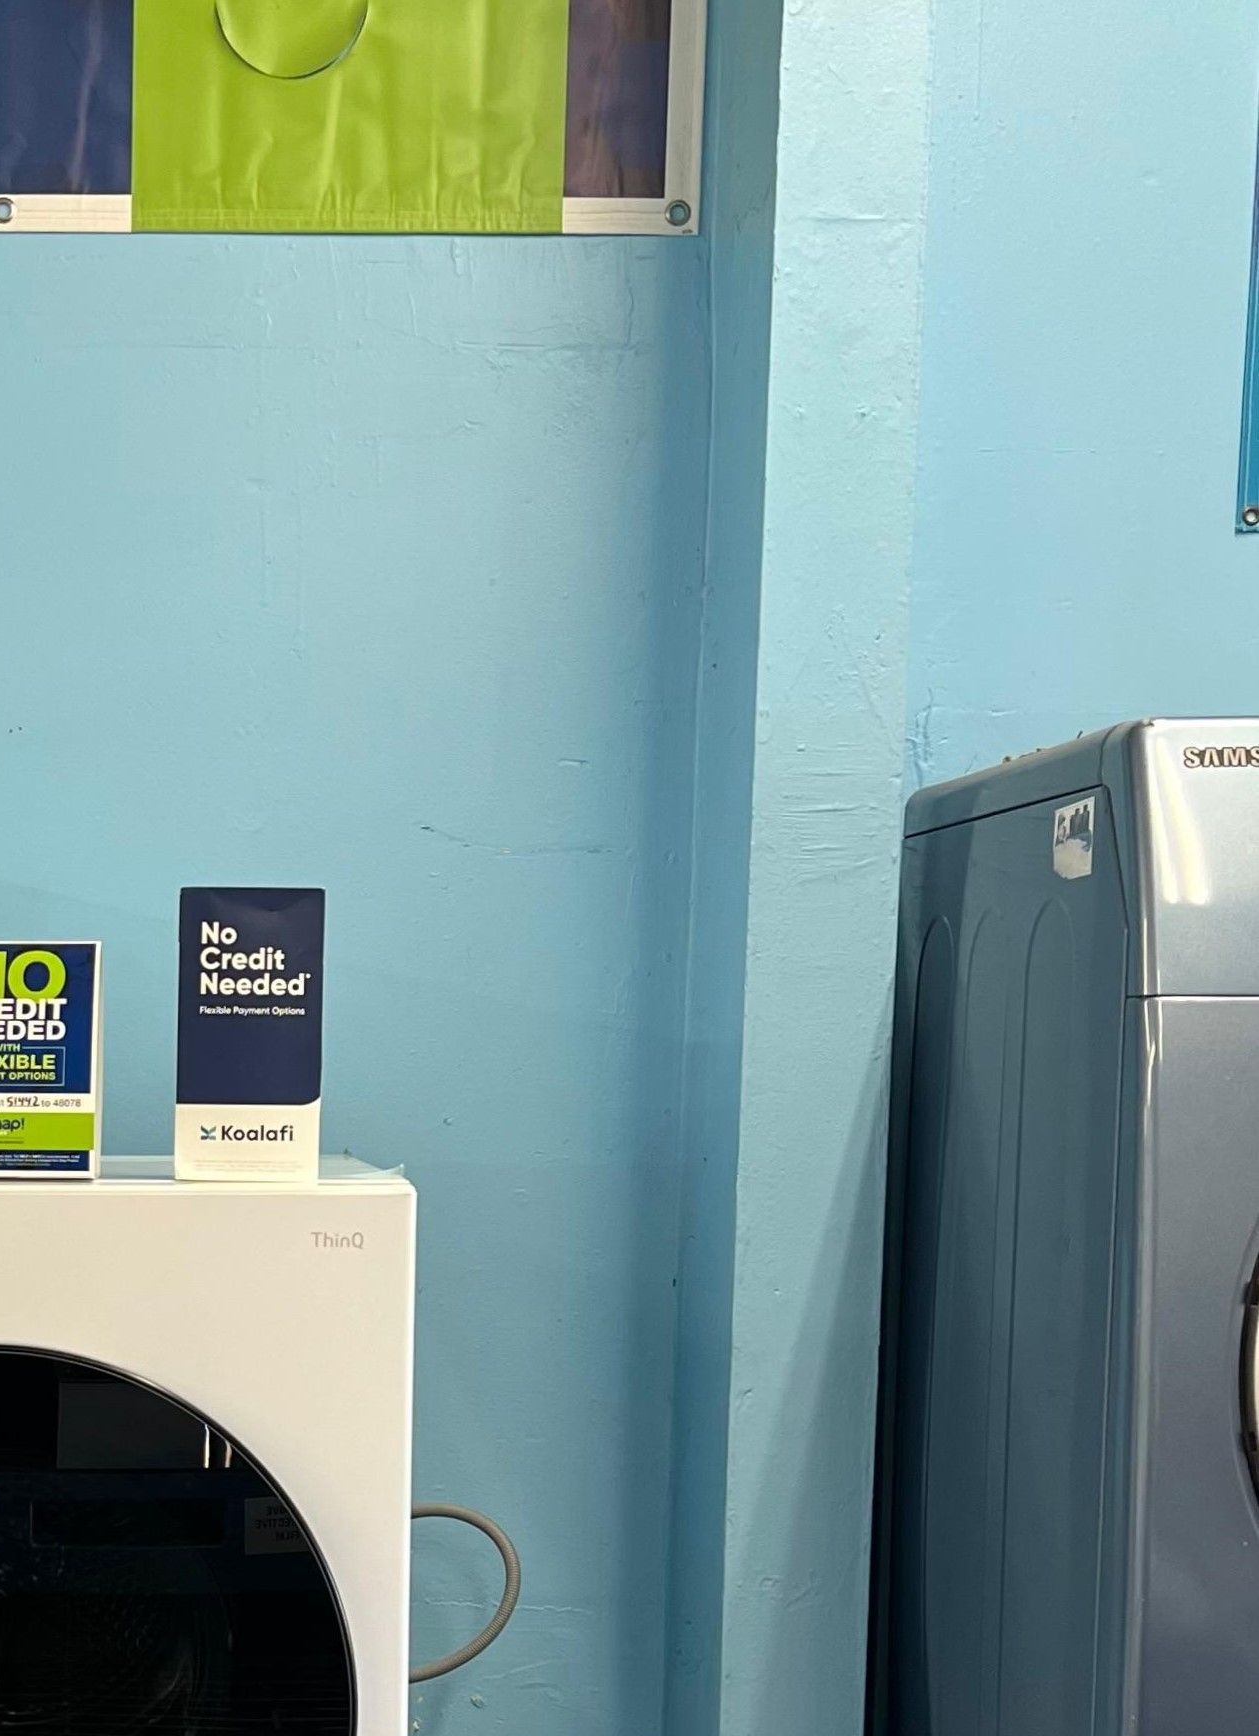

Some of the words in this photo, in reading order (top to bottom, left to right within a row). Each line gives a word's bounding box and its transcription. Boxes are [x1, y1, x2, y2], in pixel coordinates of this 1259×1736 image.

[200, 921, 238, 945] No
[200, 946, 285, 971] Credit
[199, 1006, 232, 1015] Flexible
[232, 1006, 270, 1018] Payment
[272, 1006, 306, 1018] Options
[8, 1072, 56, 1081] OPTIONS
[42, 1100, 50, 1108] to
[221, 1125, 294, 1142] Koalafi
[310, 1231, 364, 1249] ThinQ
